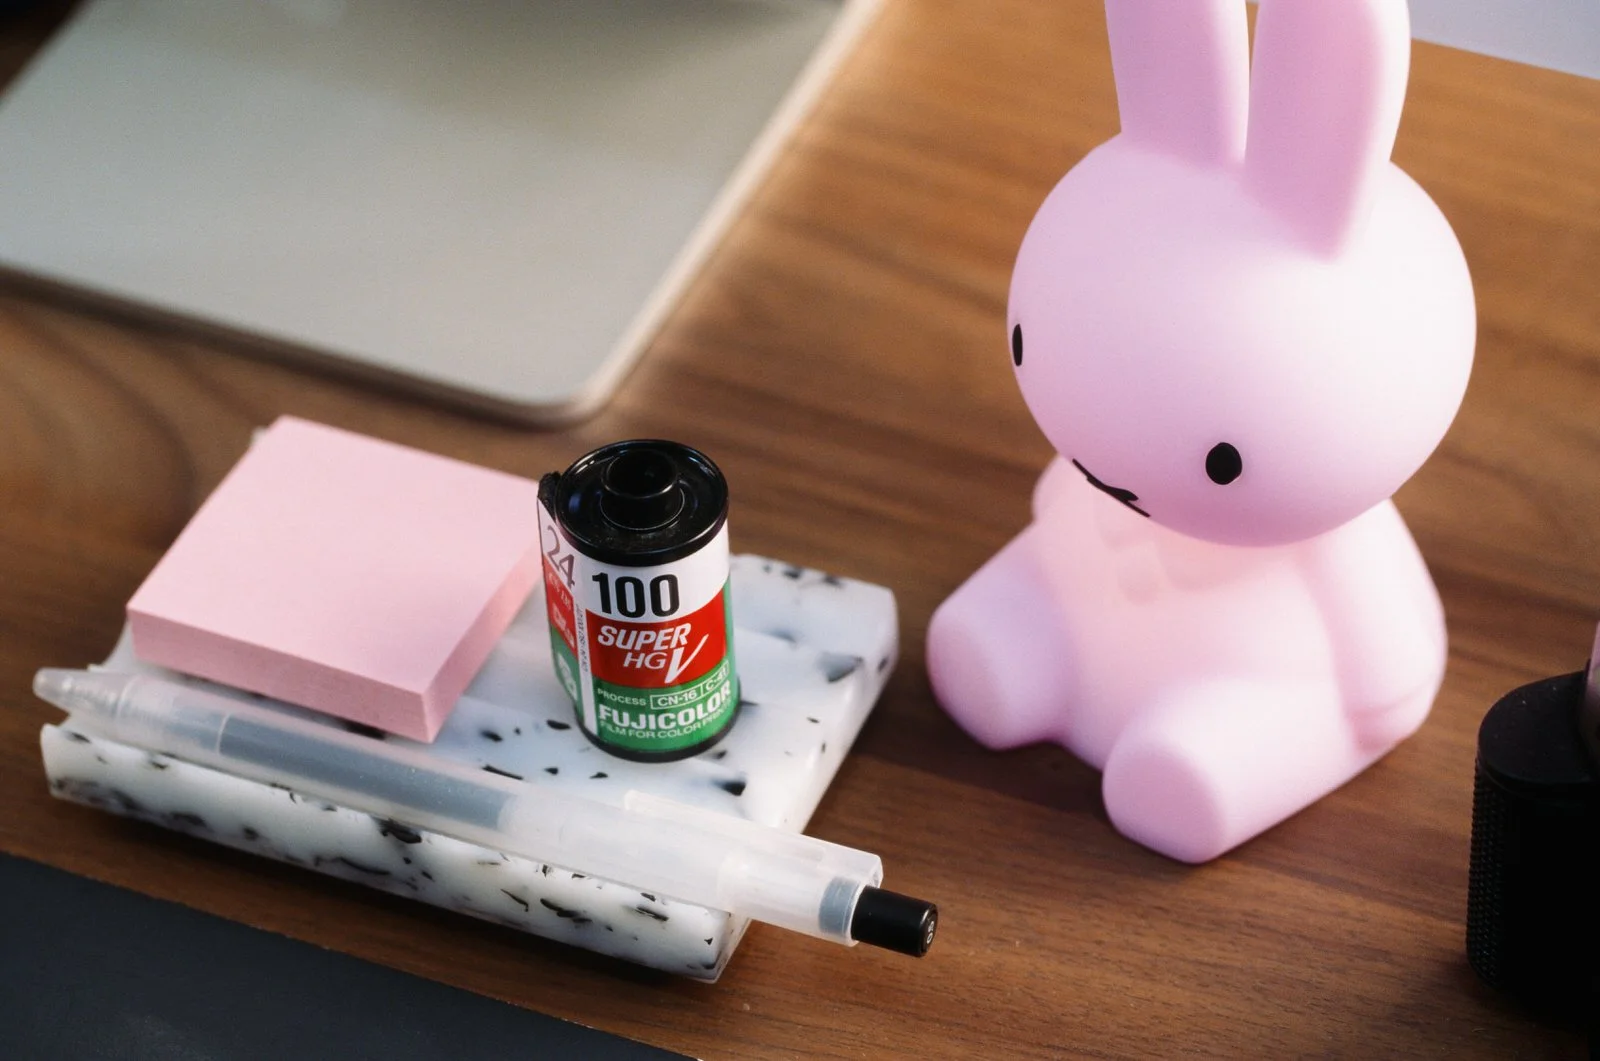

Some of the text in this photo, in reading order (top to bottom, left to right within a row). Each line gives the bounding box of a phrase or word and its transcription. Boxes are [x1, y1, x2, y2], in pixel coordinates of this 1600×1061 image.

[547, 524, 576, 590] 24
[592, 572, 680, 618] 100
[597, 622, 692, 651] SUPER
[597, 688, 647, 706] PROCESS
[657, 689, 698, 707] CN-16
[599, 679, 731, 730] FUJICOLOR
[600, 720, 626, 737] FILM
[628, 728, 656, 739] FOR
[657, 721, 702, 738] COLOR
